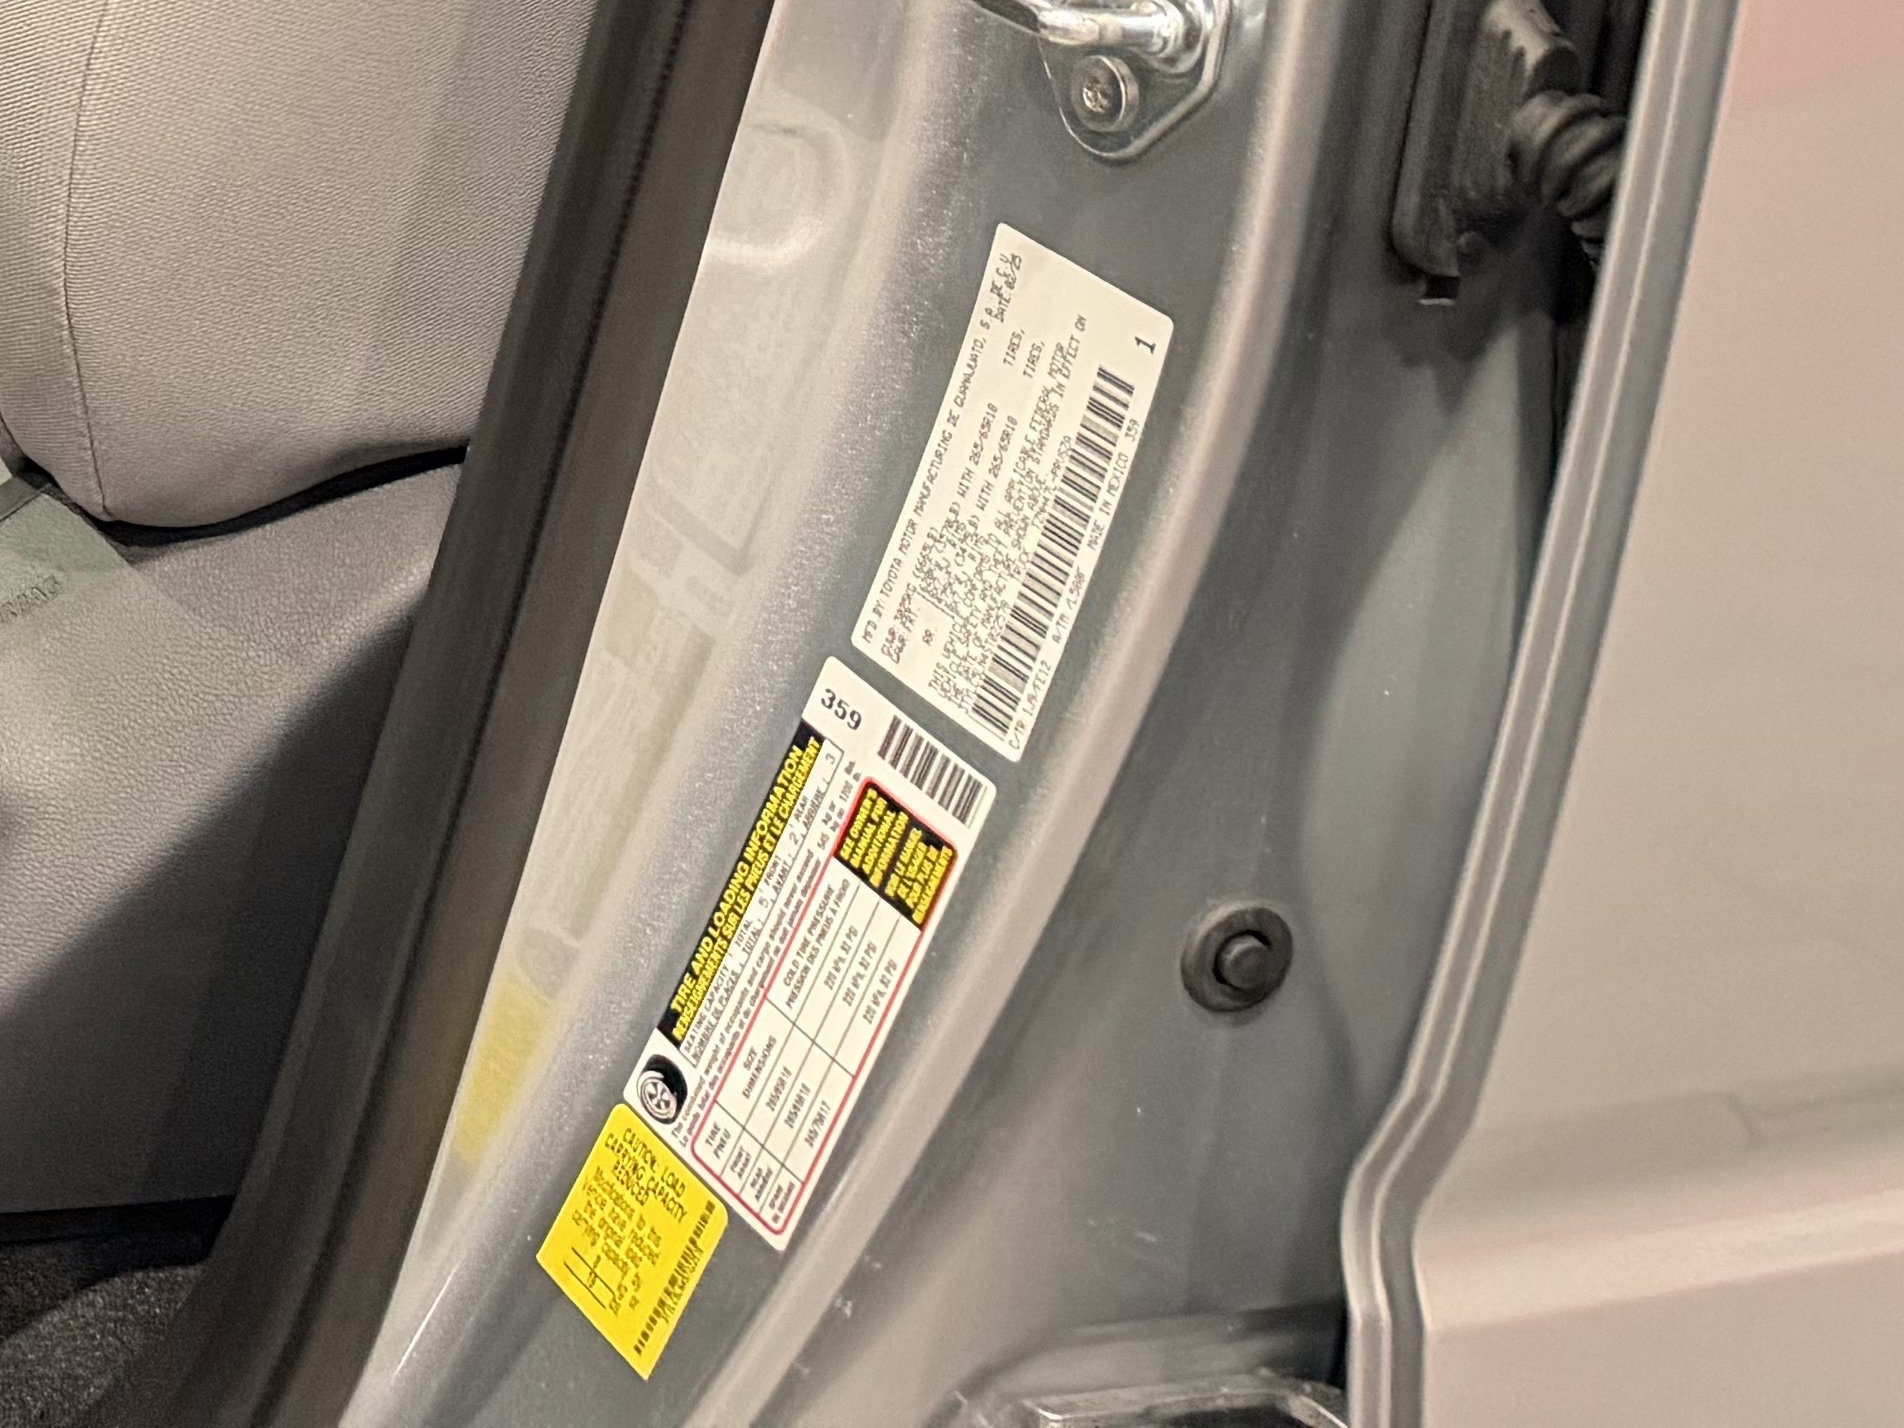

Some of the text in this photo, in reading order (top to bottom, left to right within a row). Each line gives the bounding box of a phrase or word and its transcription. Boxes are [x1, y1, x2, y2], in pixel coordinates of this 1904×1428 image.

[1073, 313, 1088, 333] ON
[1132, 332, 1156, 355] 1
[955, 325, 1025, 499] WITH 265/65R18 TIRES,
[975, 478, 994, 512] WITH
[1022, 336, 1045, 380] TIRES,
[861, 618, 877, 644] MFD
[879, 554, 903, 599] TOYOTA
[897, 516, 918, 556] MOTOR
[912, 427, 952, 519] MANUFACTURING
[946, 408, 960, 427] DE
[1085, 417, 1140, 551] MADE IN MEXICO 359
[818, 685, 864, 732] 359
[670, 743, 803, 1016] TIRE AND LOADING INFORMATION
[671, 735, 821, 1043] RENSEIGNEMENTS SUR LES PNEUS ET LE CHARGEMENT
[683, 1010, 707, 1054] SEATING
[702, 962, 730, 1013] CAPACITY
[734, 916, 752, 948] TOTAL
[757, 894, 770, 909] 5
[787, 830, 800, 845] 2
[824, 751, 836, 765] 3
[781, 882, 835, 989] COLD TIRE PRESSURE
[785, 962, 811, 1009] PRESSION
[741, 1032, 777, 1101] DIMENSIONS
[603, 1131, 647, 1183] CARRYING
[644, 1173, 688, 1226] CAPACITY
[704, 1120, 721, 1148] TIRE
[610, 1158, 650, 1208] REDUCED
[659, 1165, 686, 1200] LOAD
